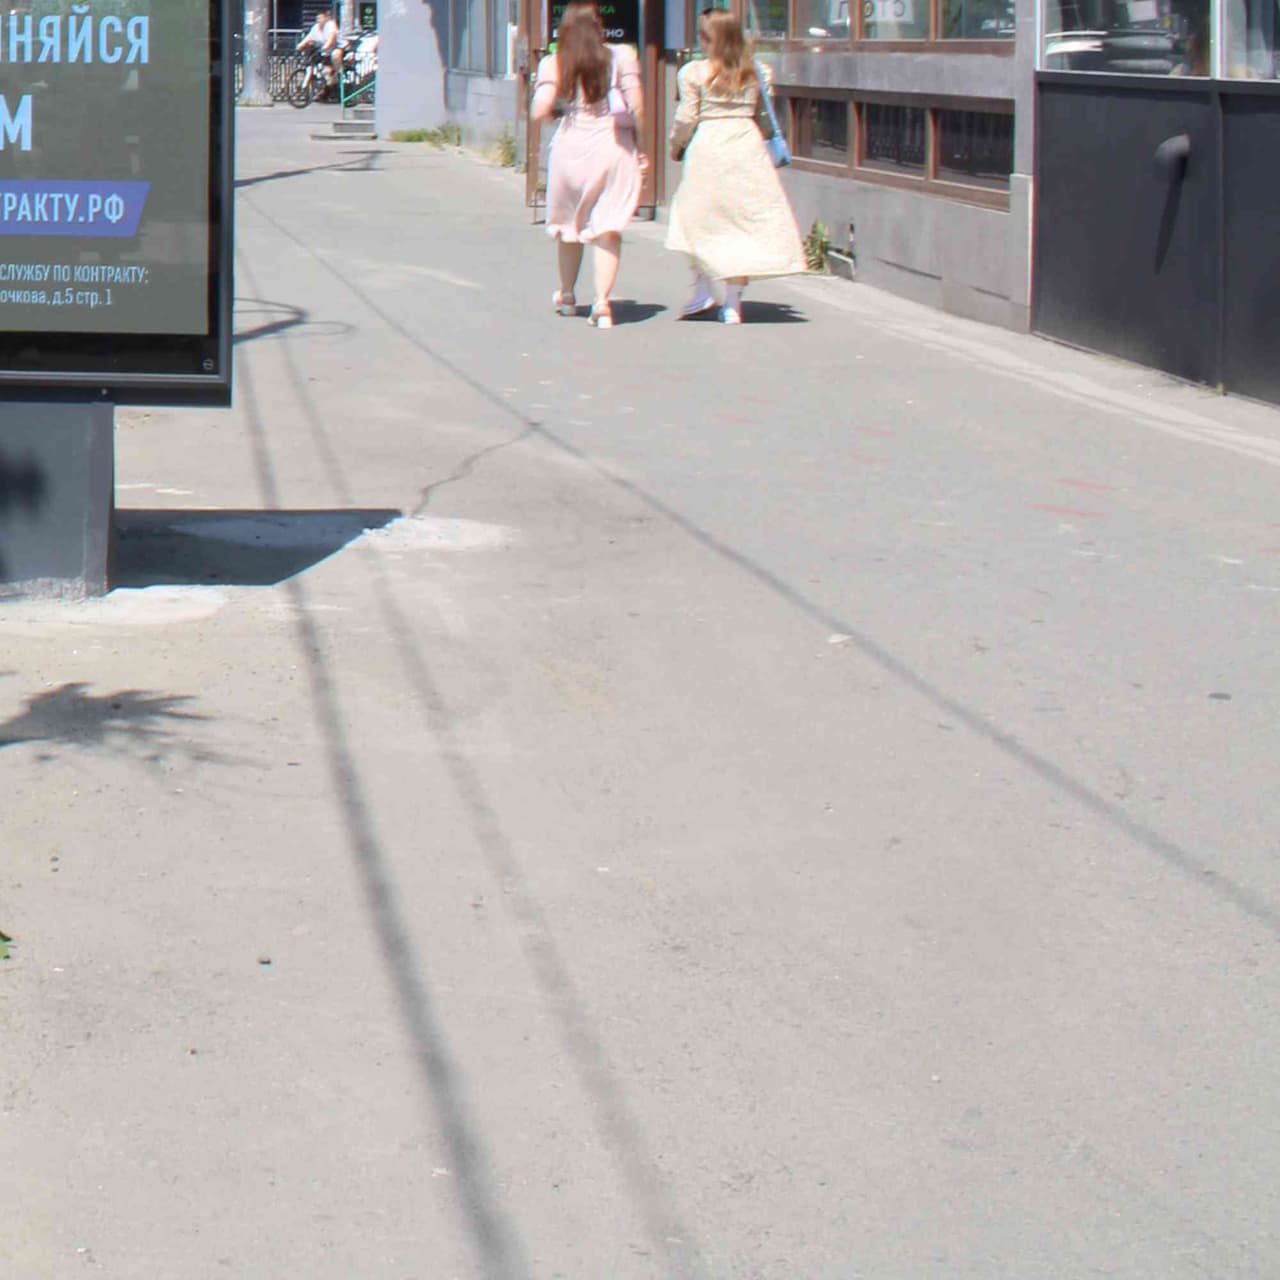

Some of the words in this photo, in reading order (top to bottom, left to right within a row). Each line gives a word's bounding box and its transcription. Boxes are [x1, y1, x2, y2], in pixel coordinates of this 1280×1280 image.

[53, 264, 71, 282] ПО
[73, 265, 150, 284] КОНТРАКТУ:
[75, 290, 103, 309] стр.
[105, 288, 113, 305] 1
